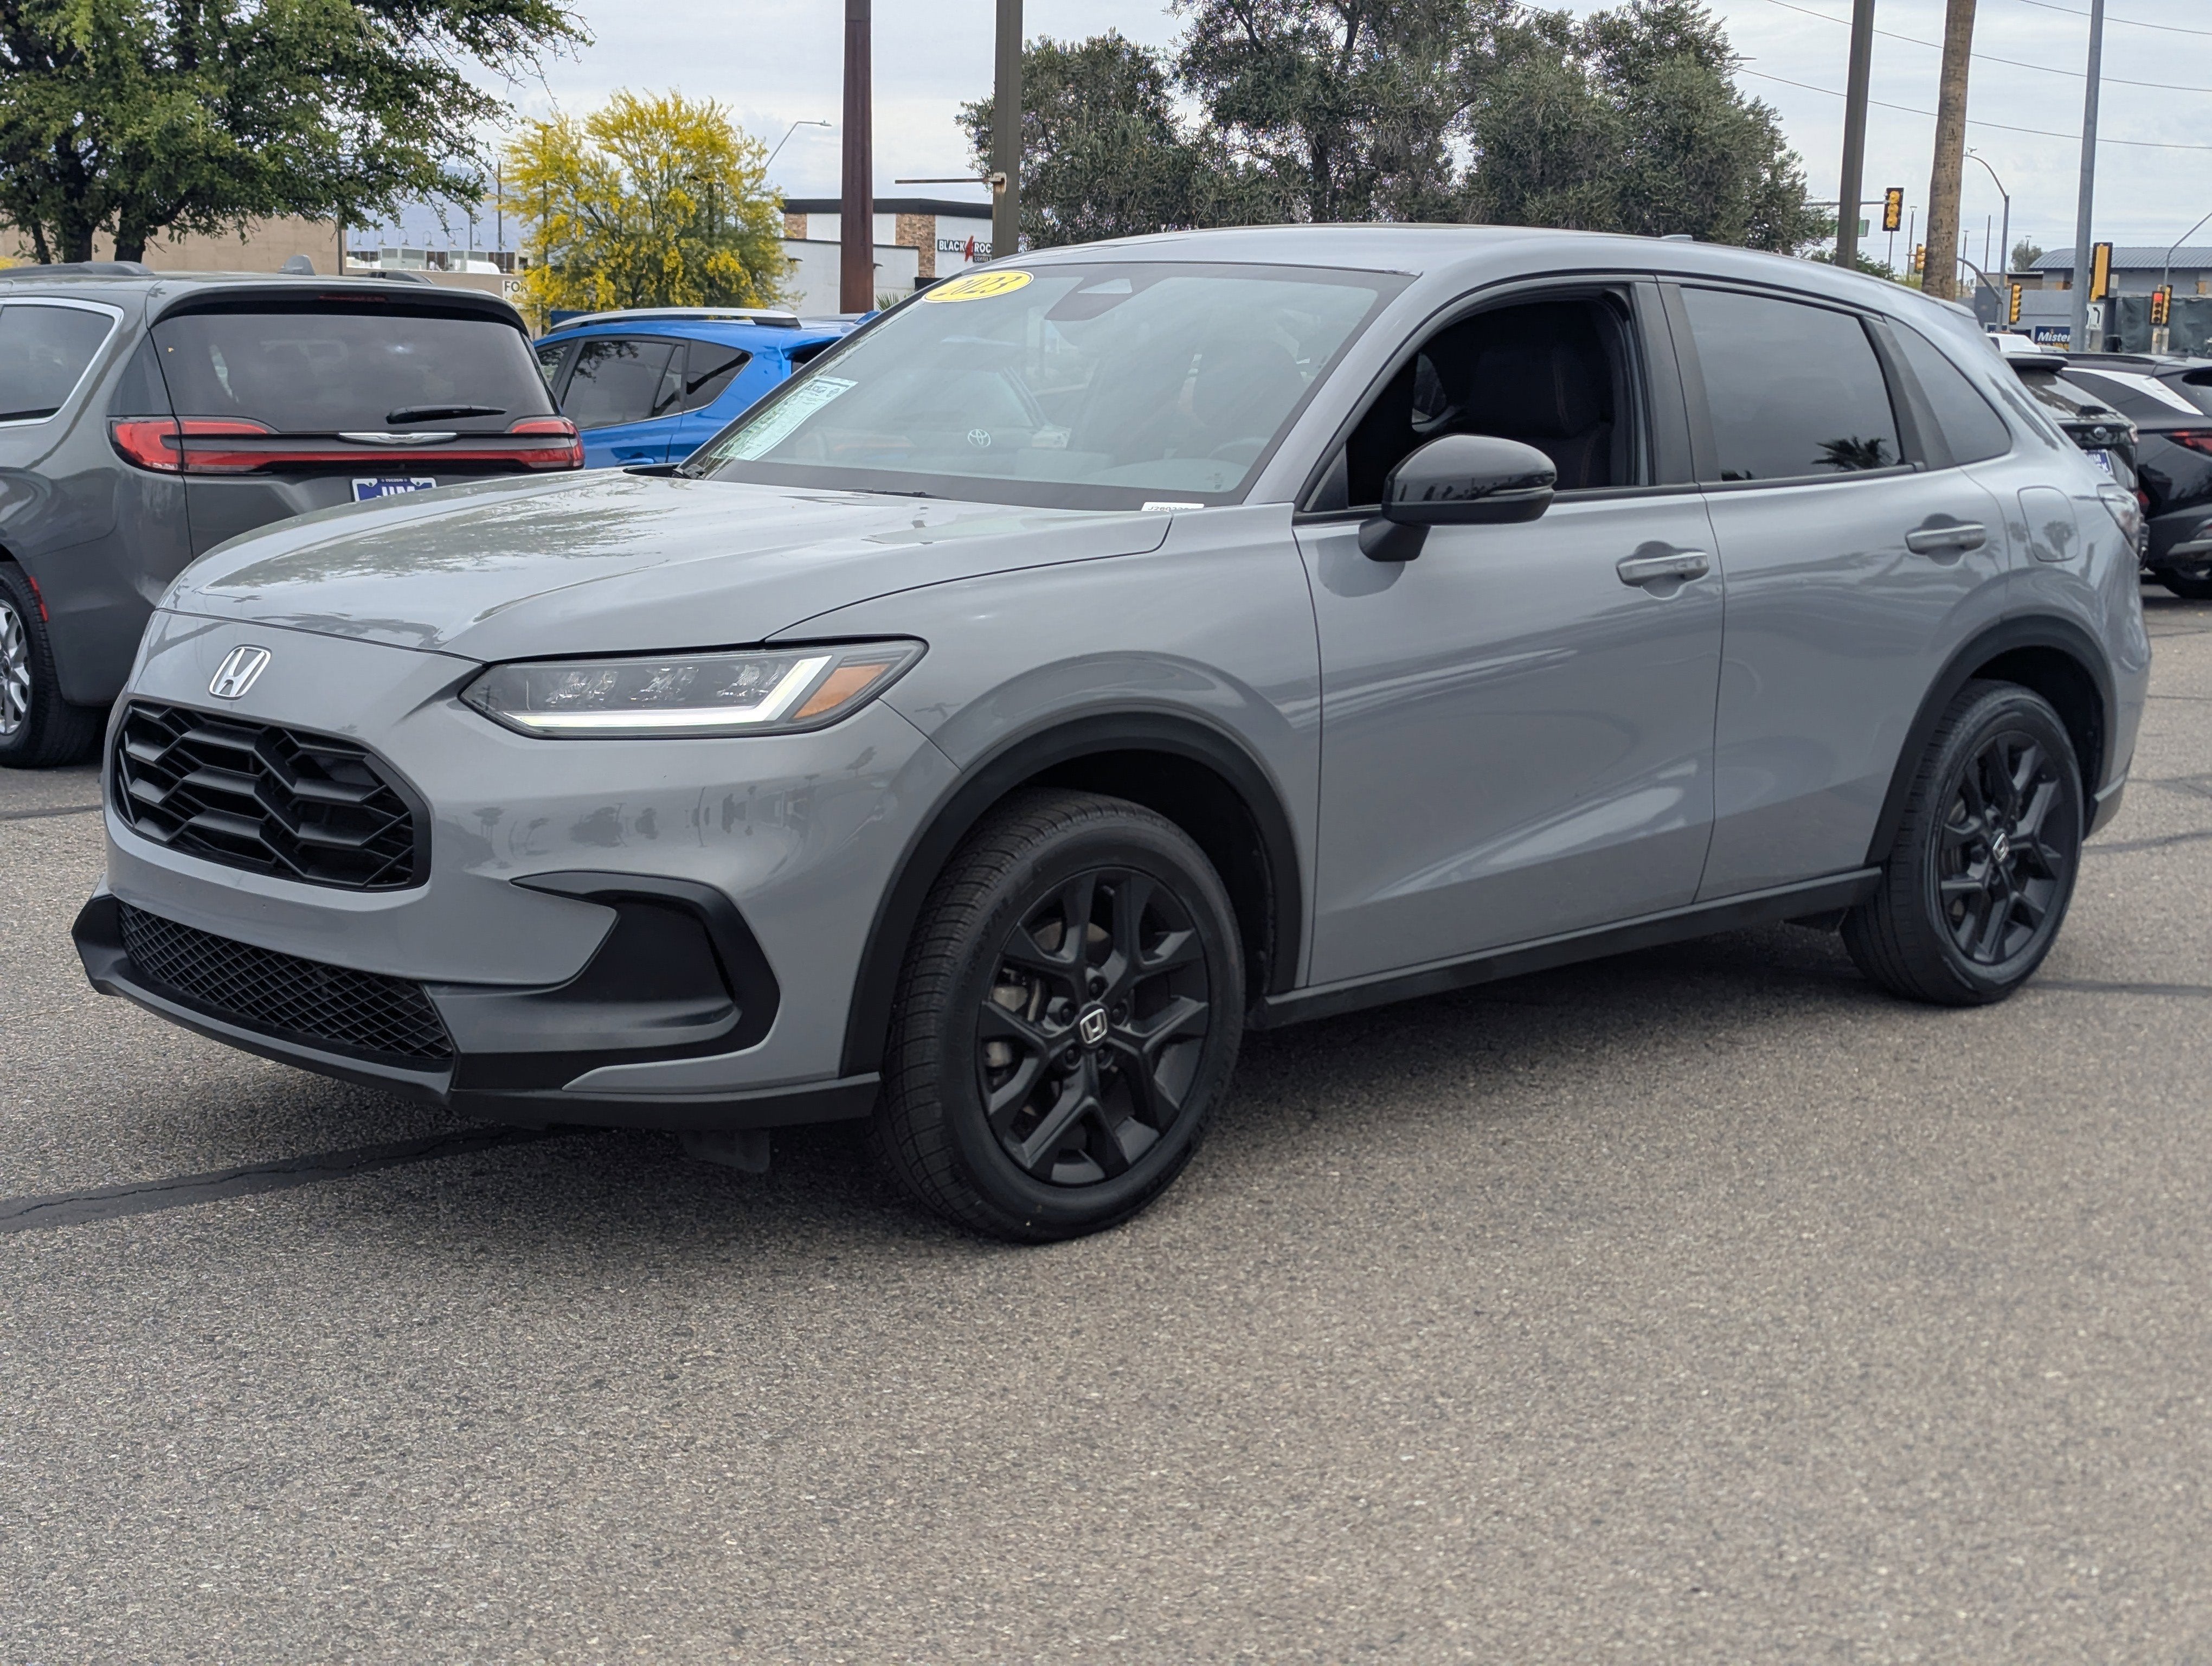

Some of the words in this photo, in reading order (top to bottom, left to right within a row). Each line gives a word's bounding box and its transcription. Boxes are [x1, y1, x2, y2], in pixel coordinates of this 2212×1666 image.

[938, 240, 965, 251] BLACK
[974, 242, 993, 253] ROC
[933, 276, 1023, 297] 2023
